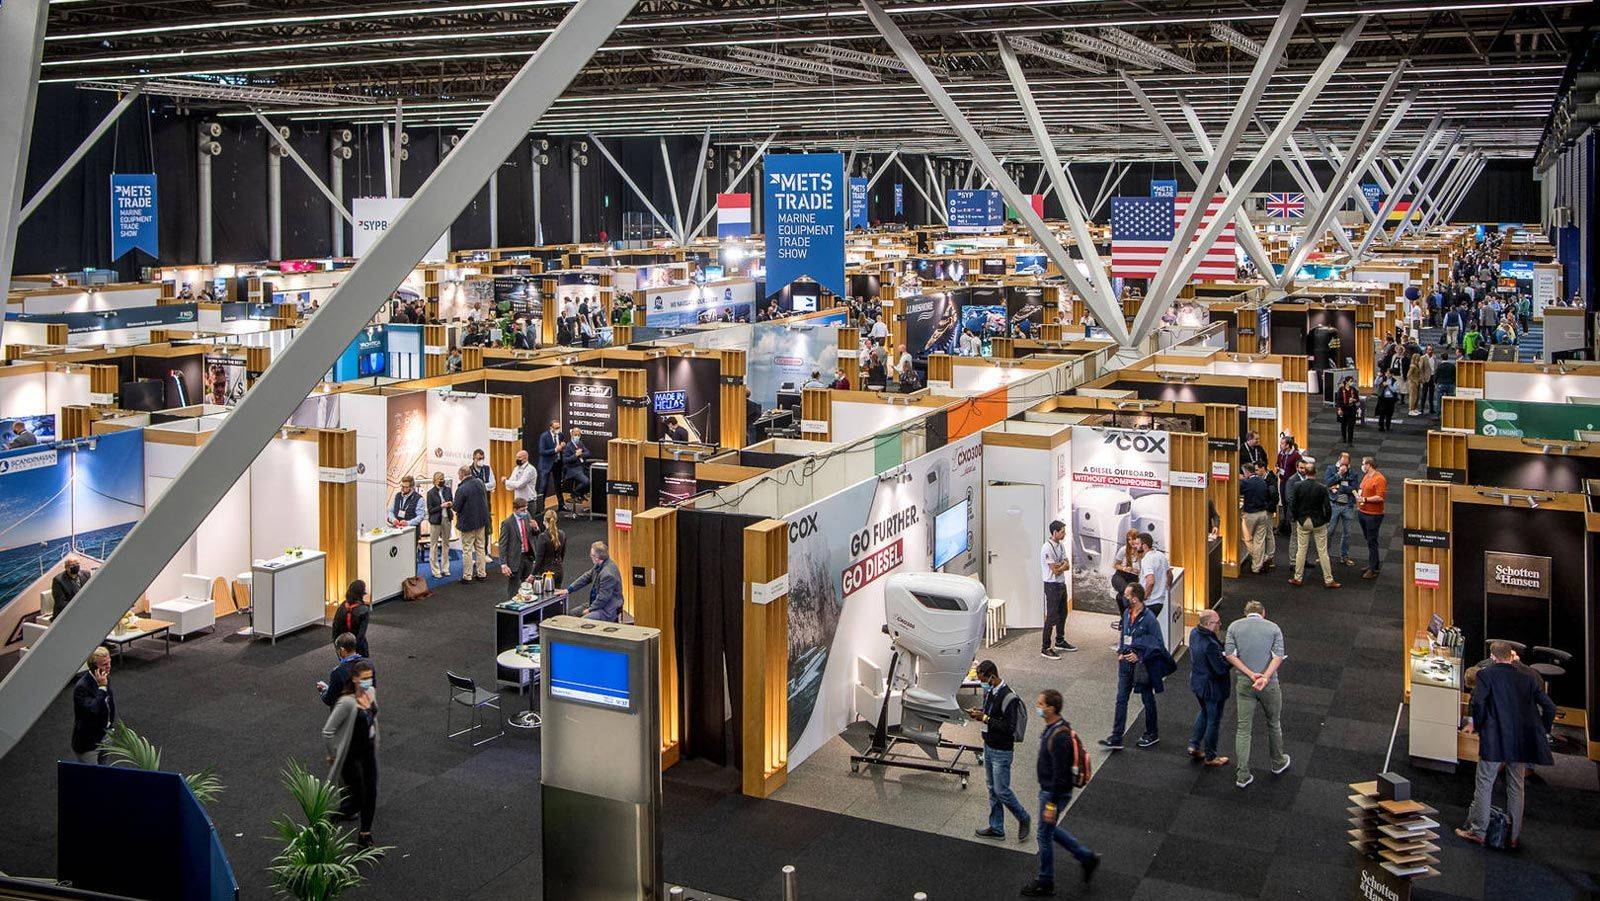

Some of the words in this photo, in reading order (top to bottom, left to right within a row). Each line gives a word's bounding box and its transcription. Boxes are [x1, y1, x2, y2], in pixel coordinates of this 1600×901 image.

[781, 172, 833, 191] METS
[121, 185, 151, 197] METS
[118, 197, 152, 208] TRADE
[775, 193, 833, 210] TRADE
[778, 213, 816, 224] MARINE
[778, 225, 834, 236] EQUIPMENT
[778, 236, 811, 247] TRADE
[778, 248, 808, 259] SHOW
[677, 392, 685, 400] IN
[655, 400, 685, 410] HELLAS
[1116, 434, 1166, 454] COX
[957, 444, 983, 466] CXO300
[1090, 467, 1112, 475] DIESEL
[1114, 468, 1156, 478] OUTBOARD.
[1074, 474, 1107, 483] WITHOUT
[1107, 477, 1160, 488] COMPROMISE.
[789, 511, 818, 543] COX
[851, 529, 870, 557] GO
[873, 505, 919, 546] FURTHER.
[843, 565, 862, 594] GO
[866, 544, 903, 582] DIESEL.
[1495, 564, 1540, 578] Schotten
[1361, 869, 1399, 901] Schotten
